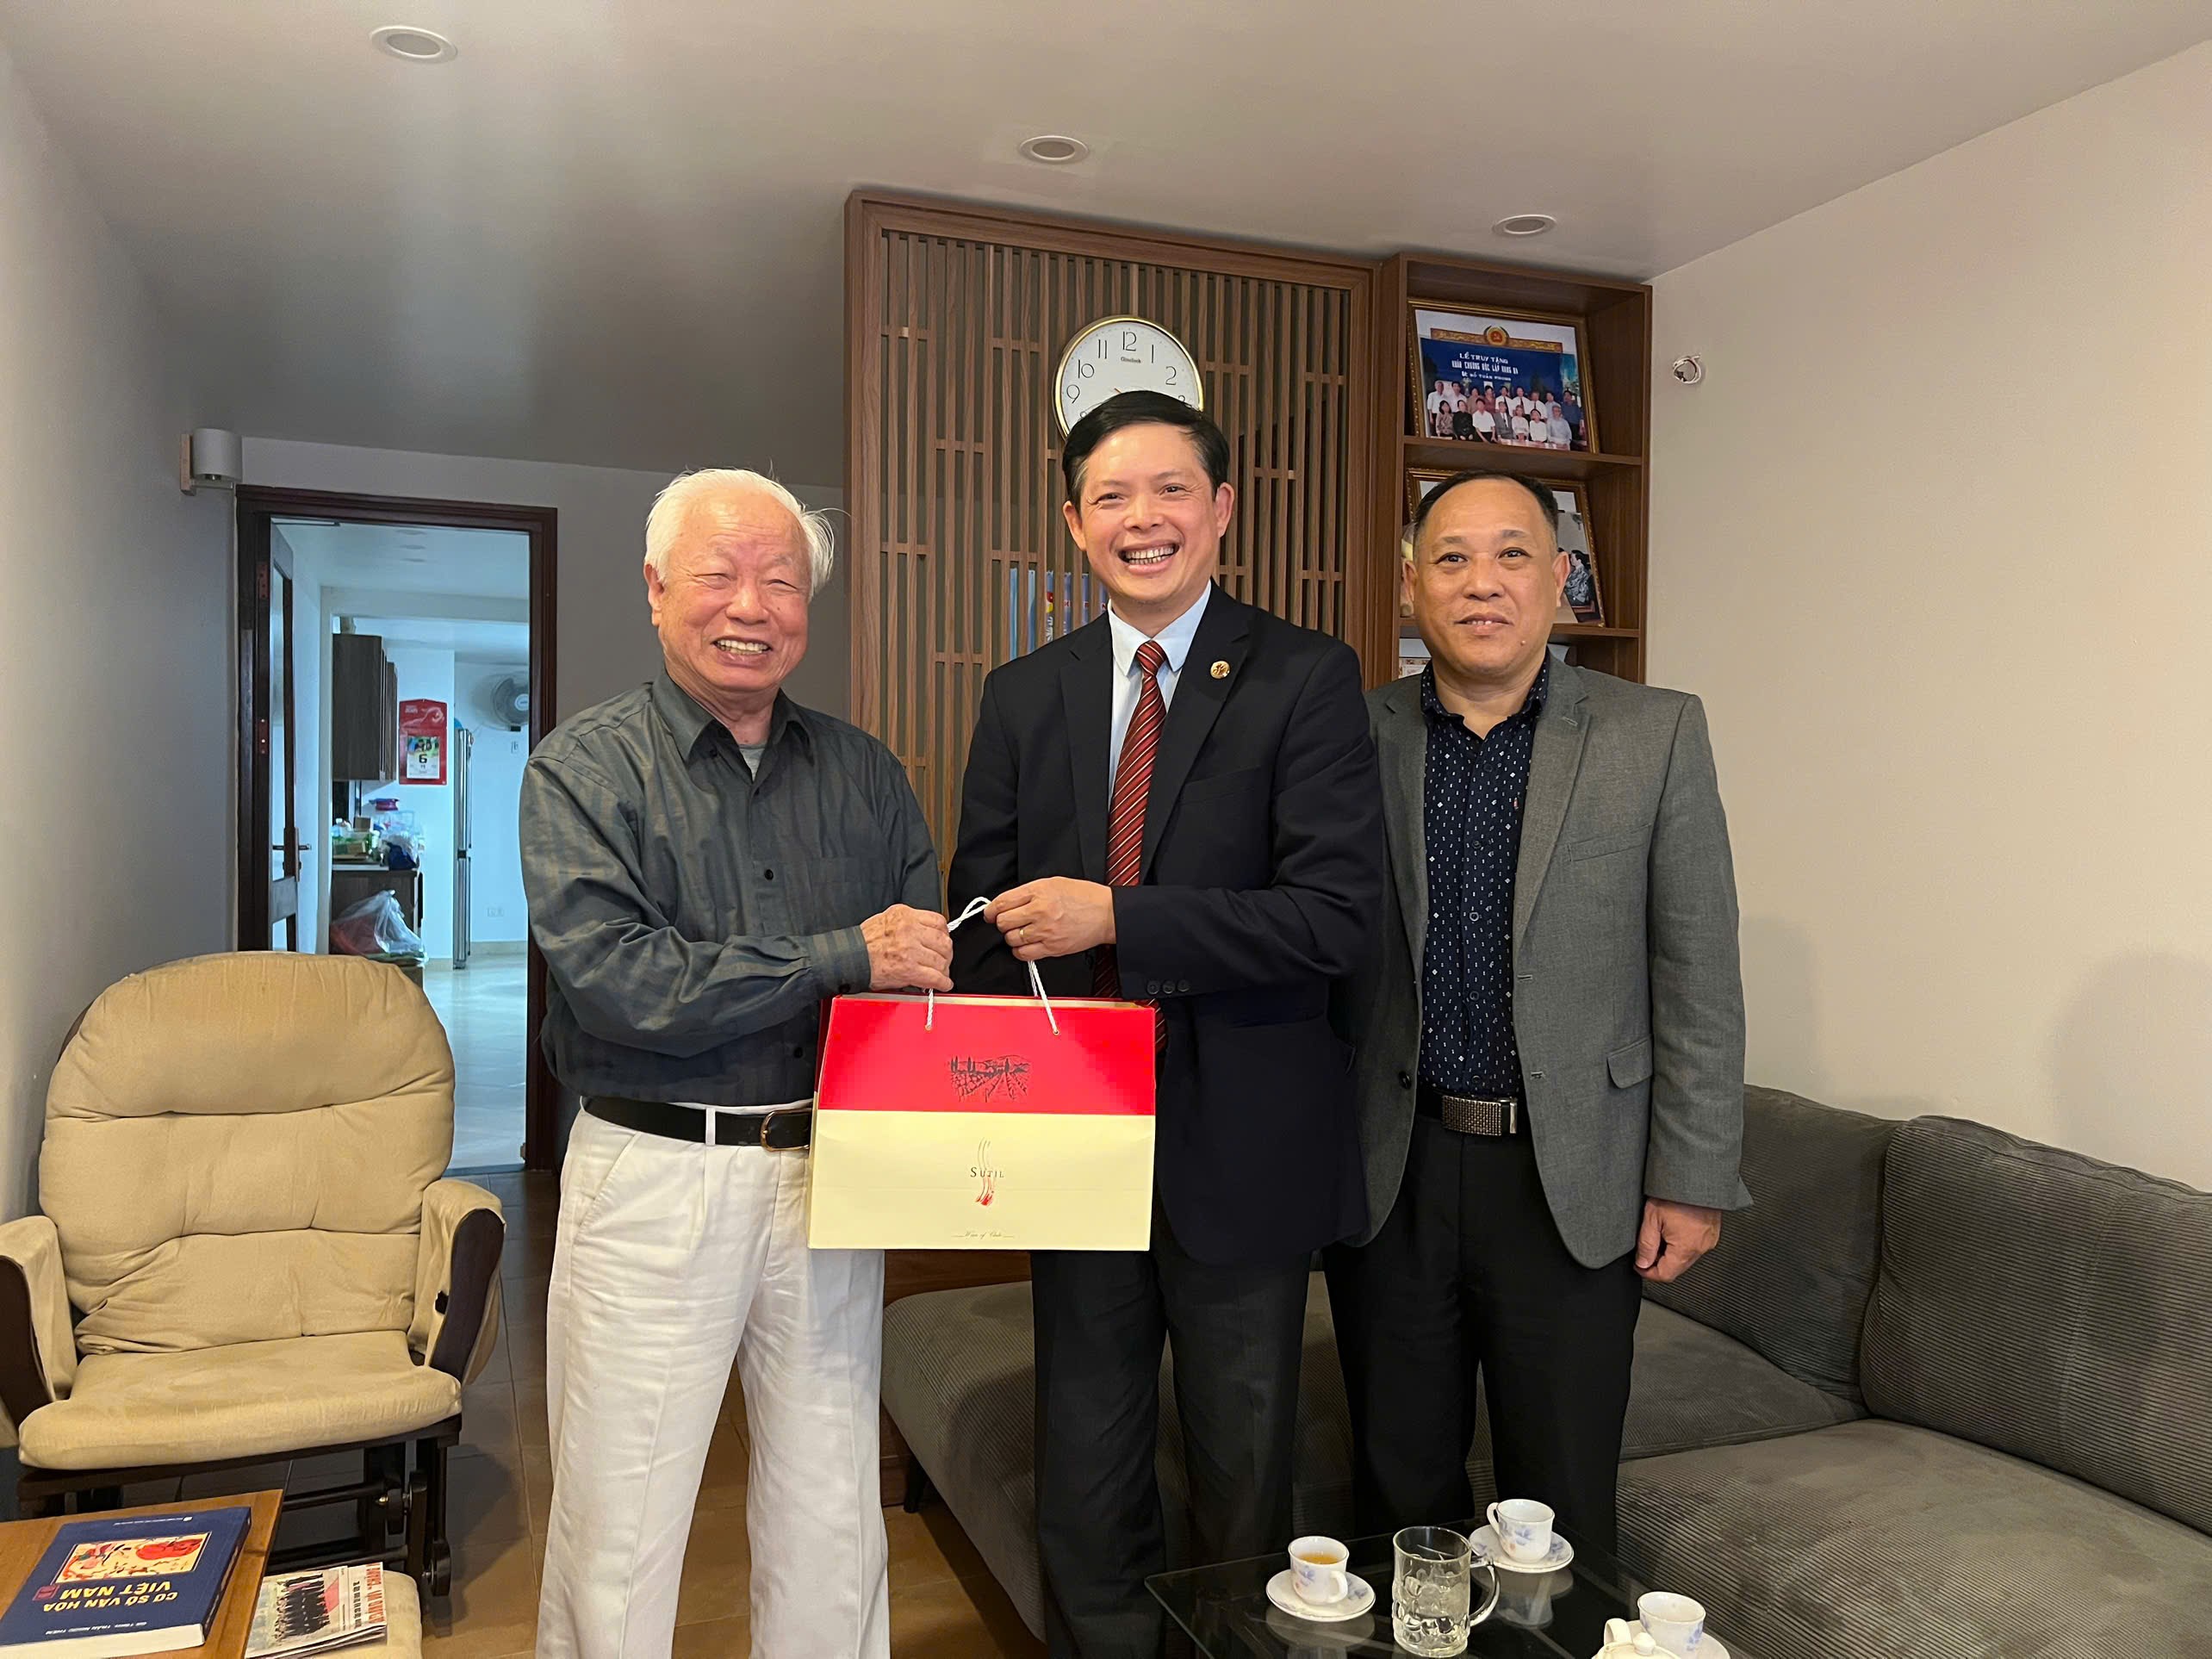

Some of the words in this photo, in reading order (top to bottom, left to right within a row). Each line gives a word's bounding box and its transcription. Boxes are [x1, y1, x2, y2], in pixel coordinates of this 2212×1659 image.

[1098, 339, 1108, 359] 11
[1122, 331, 1137, 351] 12
[1151, 345, 1154, 363] 1
[1078, 359, 1095, 379] 10
[1165, 366, 1177, 385] 2
[1066, 384, 1080, 404] 9
[419, 754, 427, 763] 6
[59, 1586, 115, 1600] NAM
[119, 1581, 171, 1595] VIỆT
[152, 1591, 178, 1603] CƠ
[84, 1597, 121, 1608] VĂN
